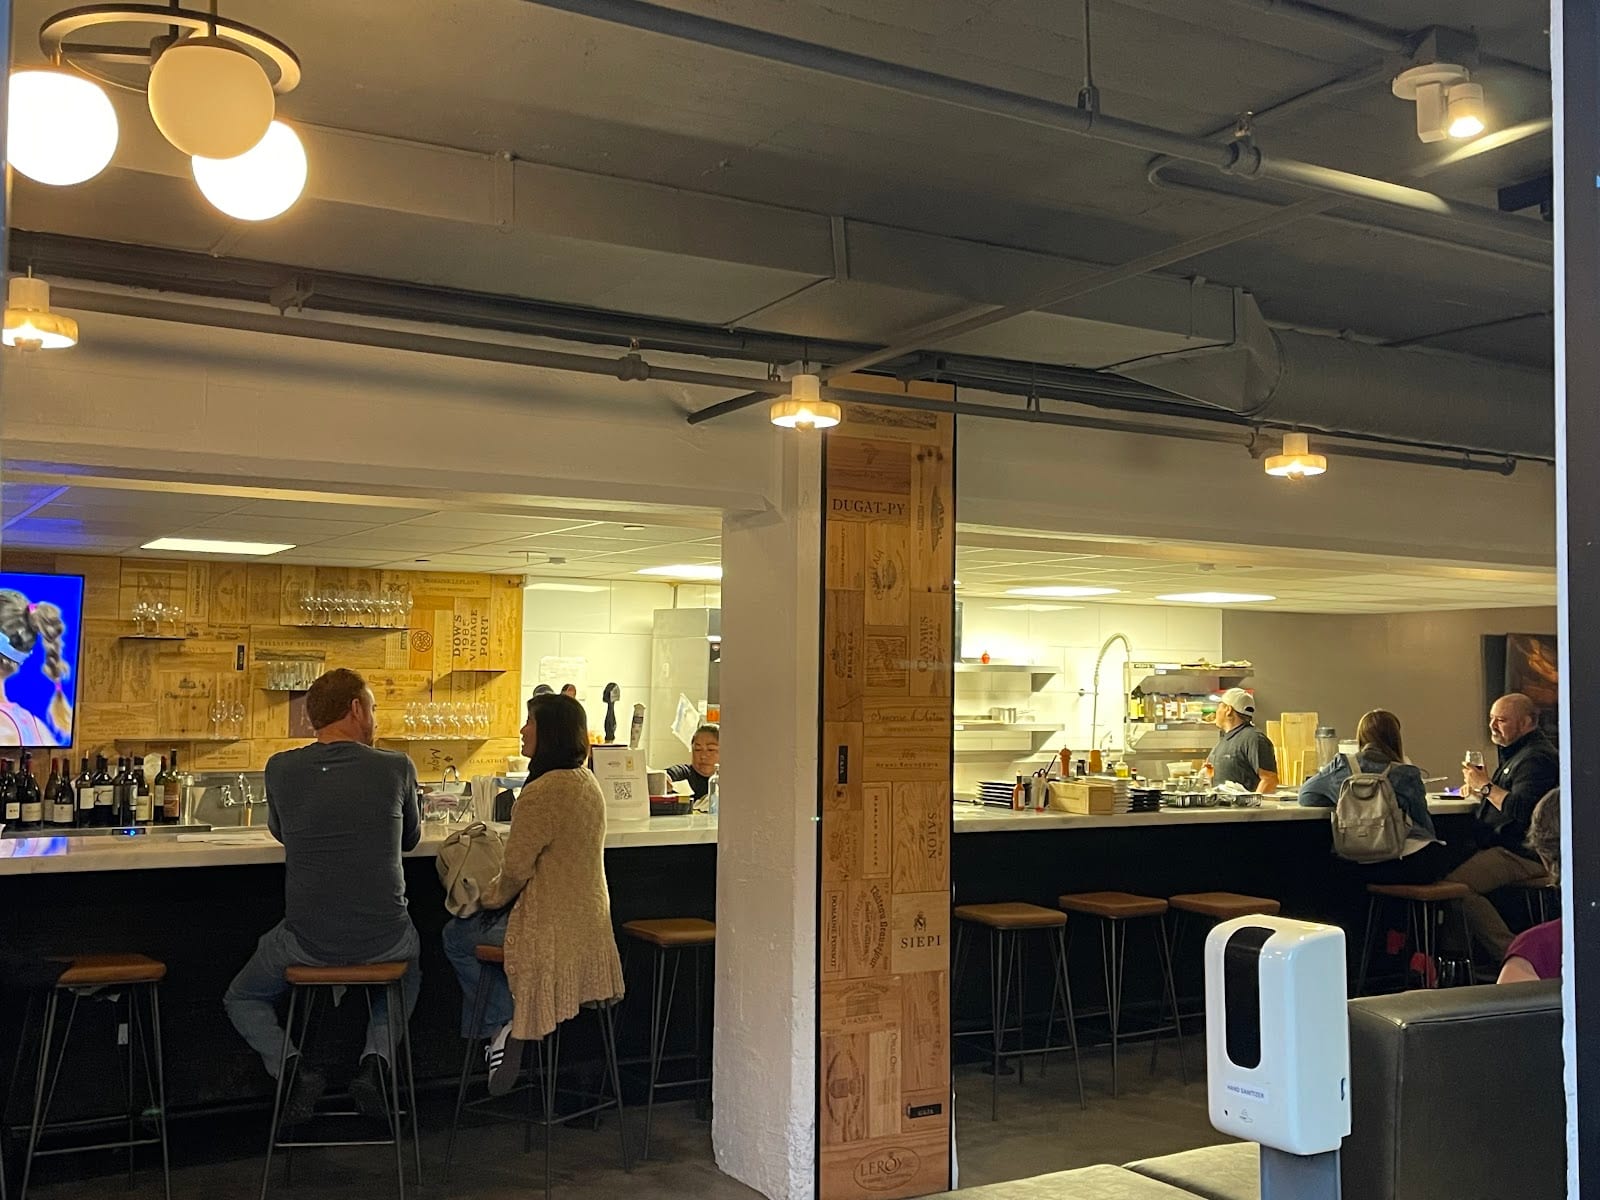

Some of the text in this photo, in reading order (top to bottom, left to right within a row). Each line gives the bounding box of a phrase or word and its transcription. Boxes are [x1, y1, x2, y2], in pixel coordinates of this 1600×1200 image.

[832, 498, 906, 516] DUGAT-PY
[452, 614, 462, 657] DOW'S
[462, 619, 470, 651] 1985
[469, 608, 478, 662] VINTAGE
[479, 616, 489, 657] PORT
[900, 935, 941, 949] SIEPI
